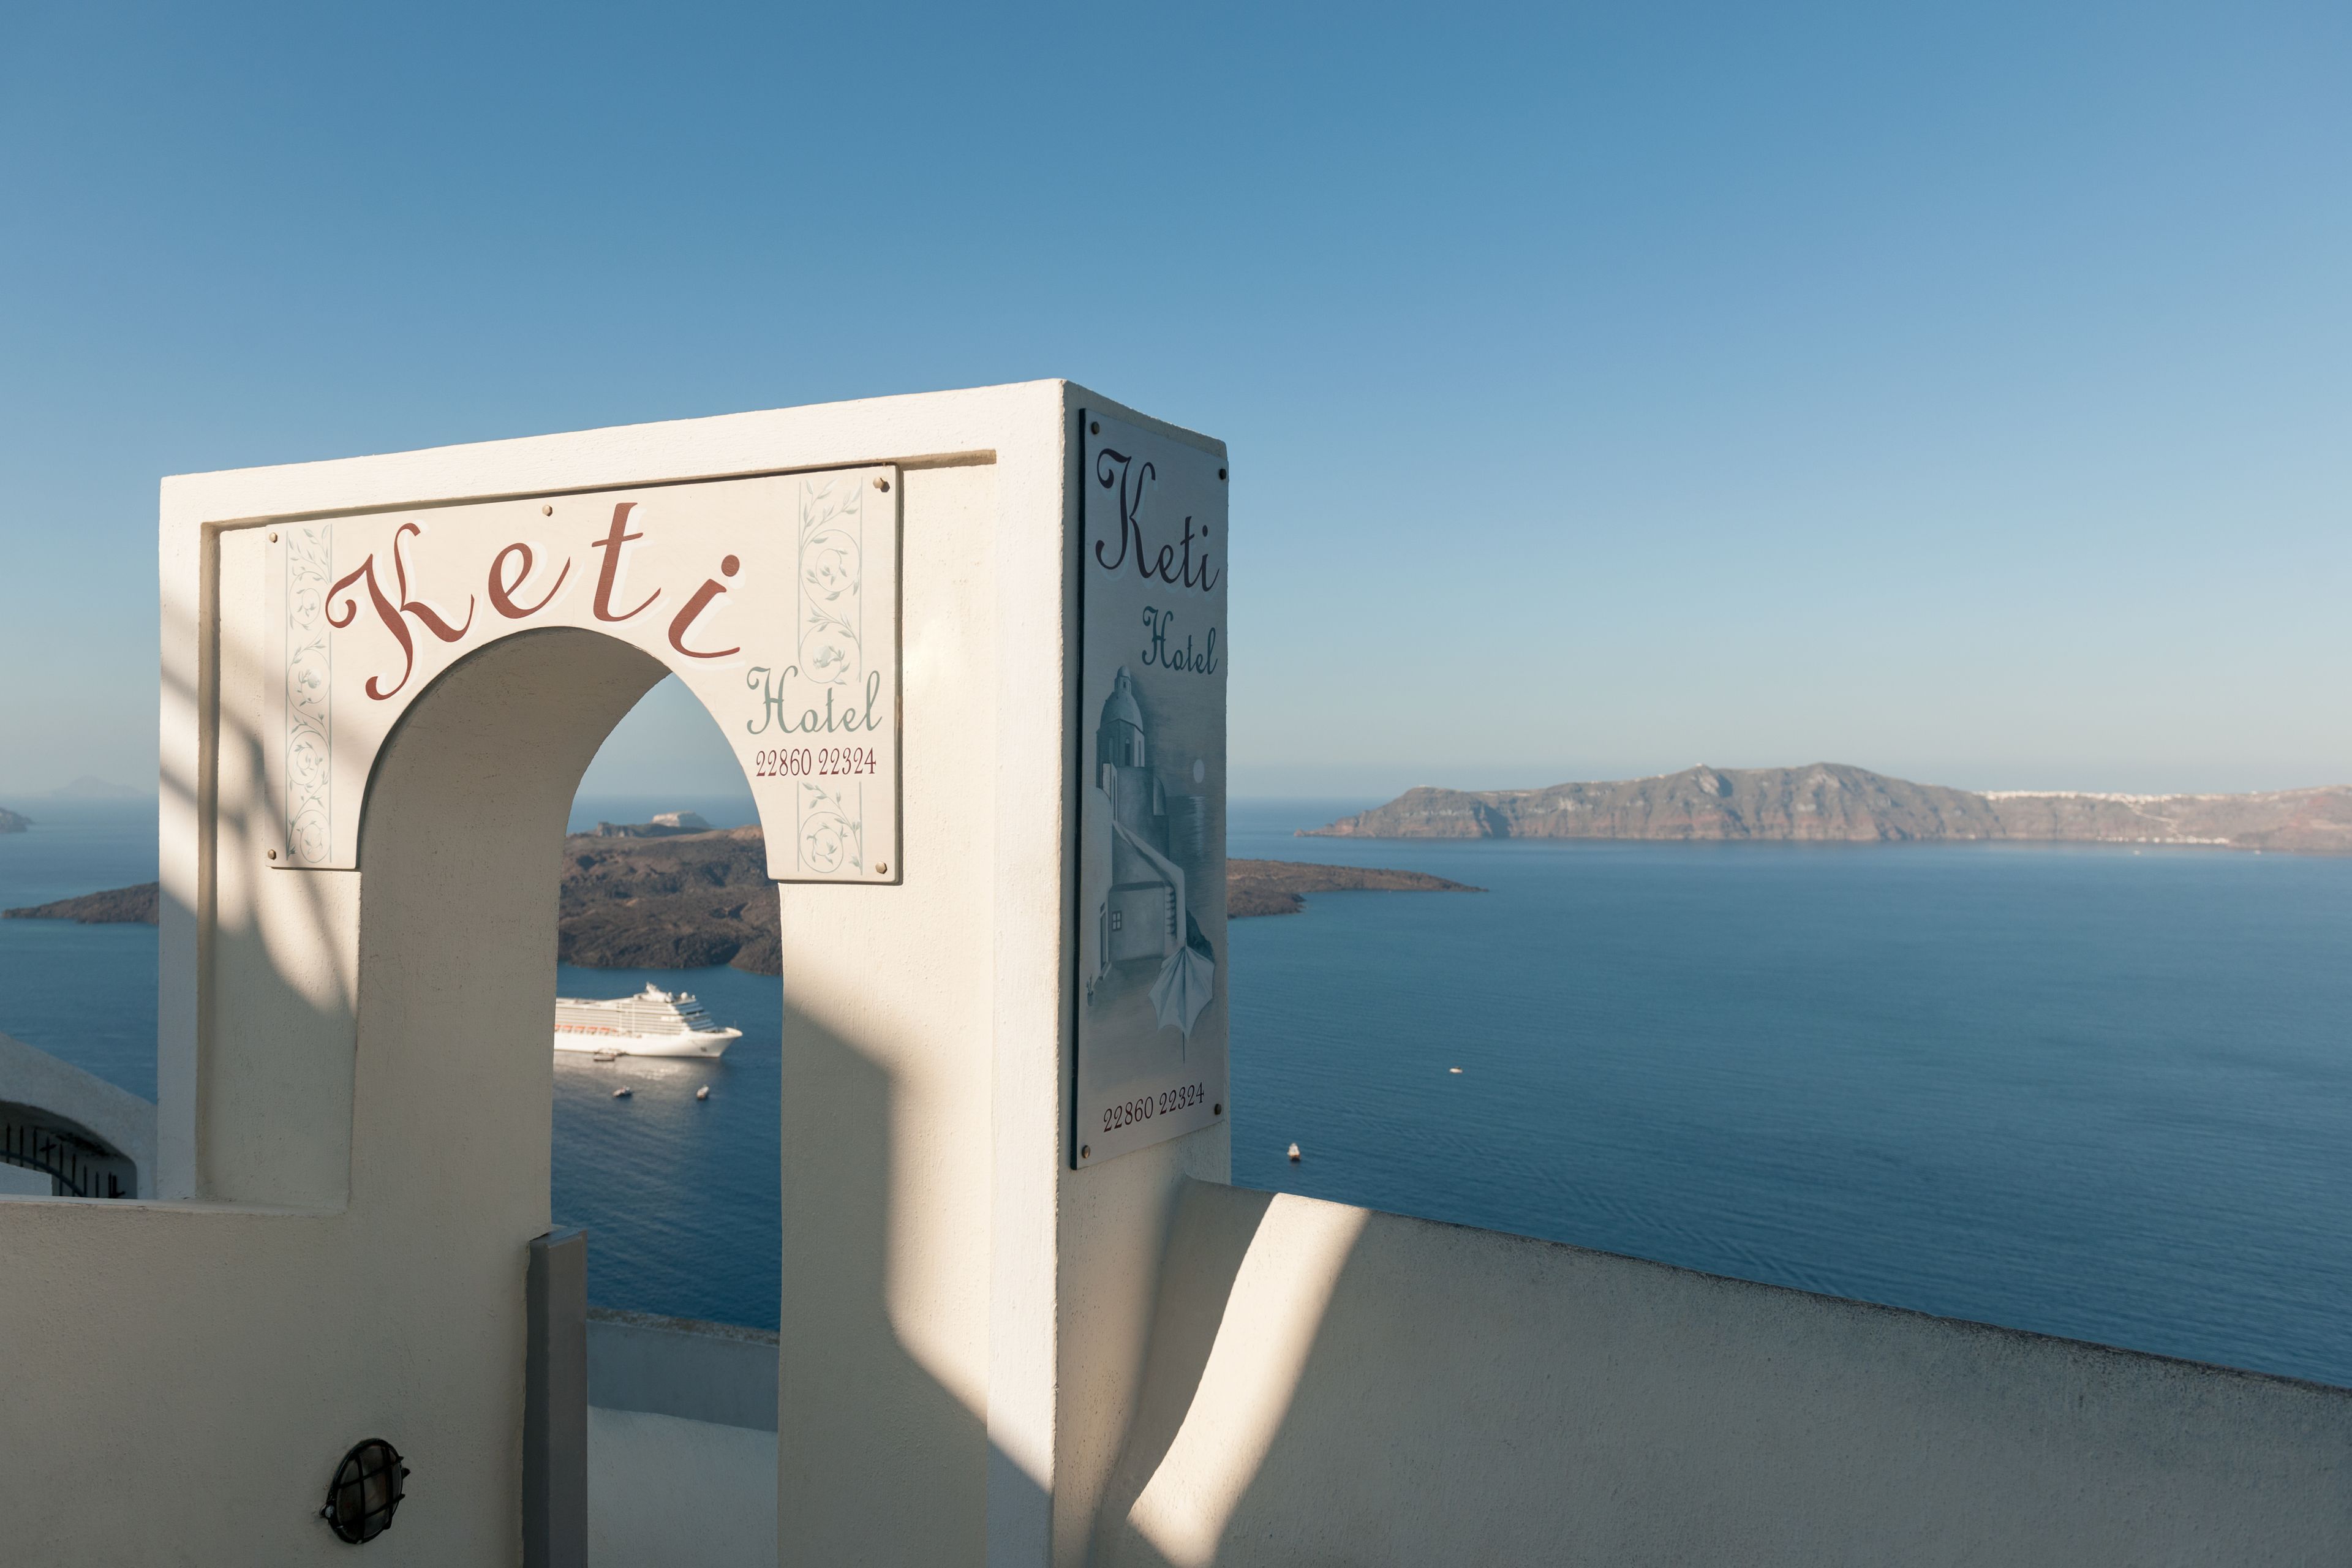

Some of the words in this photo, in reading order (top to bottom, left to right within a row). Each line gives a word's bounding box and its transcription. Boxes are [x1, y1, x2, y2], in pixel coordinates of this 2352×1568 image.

[1095, 448, 1219, 592] Keti
[325, 502, 741, 701] Keti
[1142, 606, 1218, 675] Hotel
[746, 666, 882, 736] Hotel
[755, 748, 812, 777] 22860
[818, 747, 876, 775] 22324
[1103, 1096, 1153, 1133] 22860
[1159, 1082, 1205, 1116] 22324
